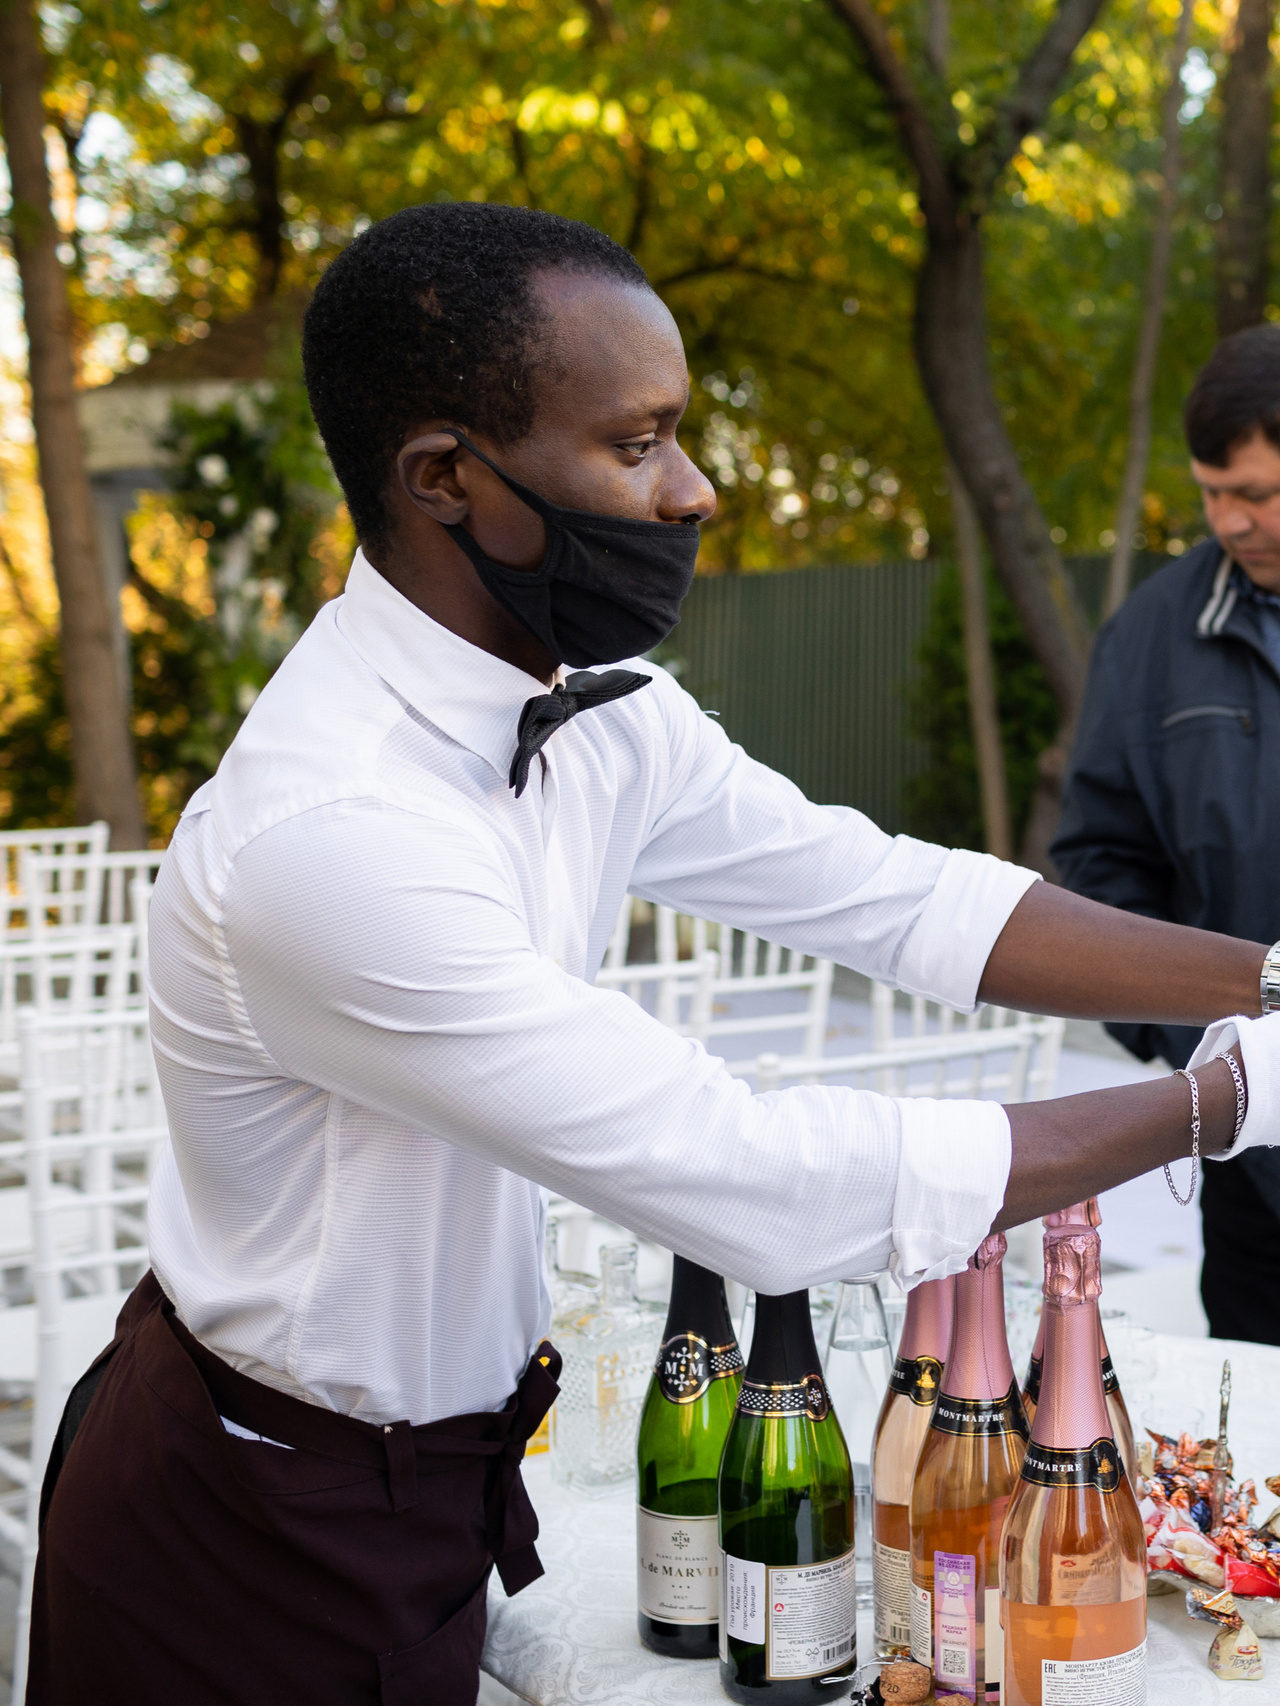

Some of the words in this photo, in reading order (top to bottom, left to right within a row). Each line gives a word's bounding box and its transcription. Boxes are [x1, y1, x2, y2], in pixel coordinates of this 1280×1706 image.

[938, 1407, 1005, 1423] MONTMARTRE
[1024, 1453, 1082, 1472] ONTMARTRE
[648, 1561, 659, 1574] de
[938, 1562, 971, 1570] ФЕДЕРАЦИЯ
